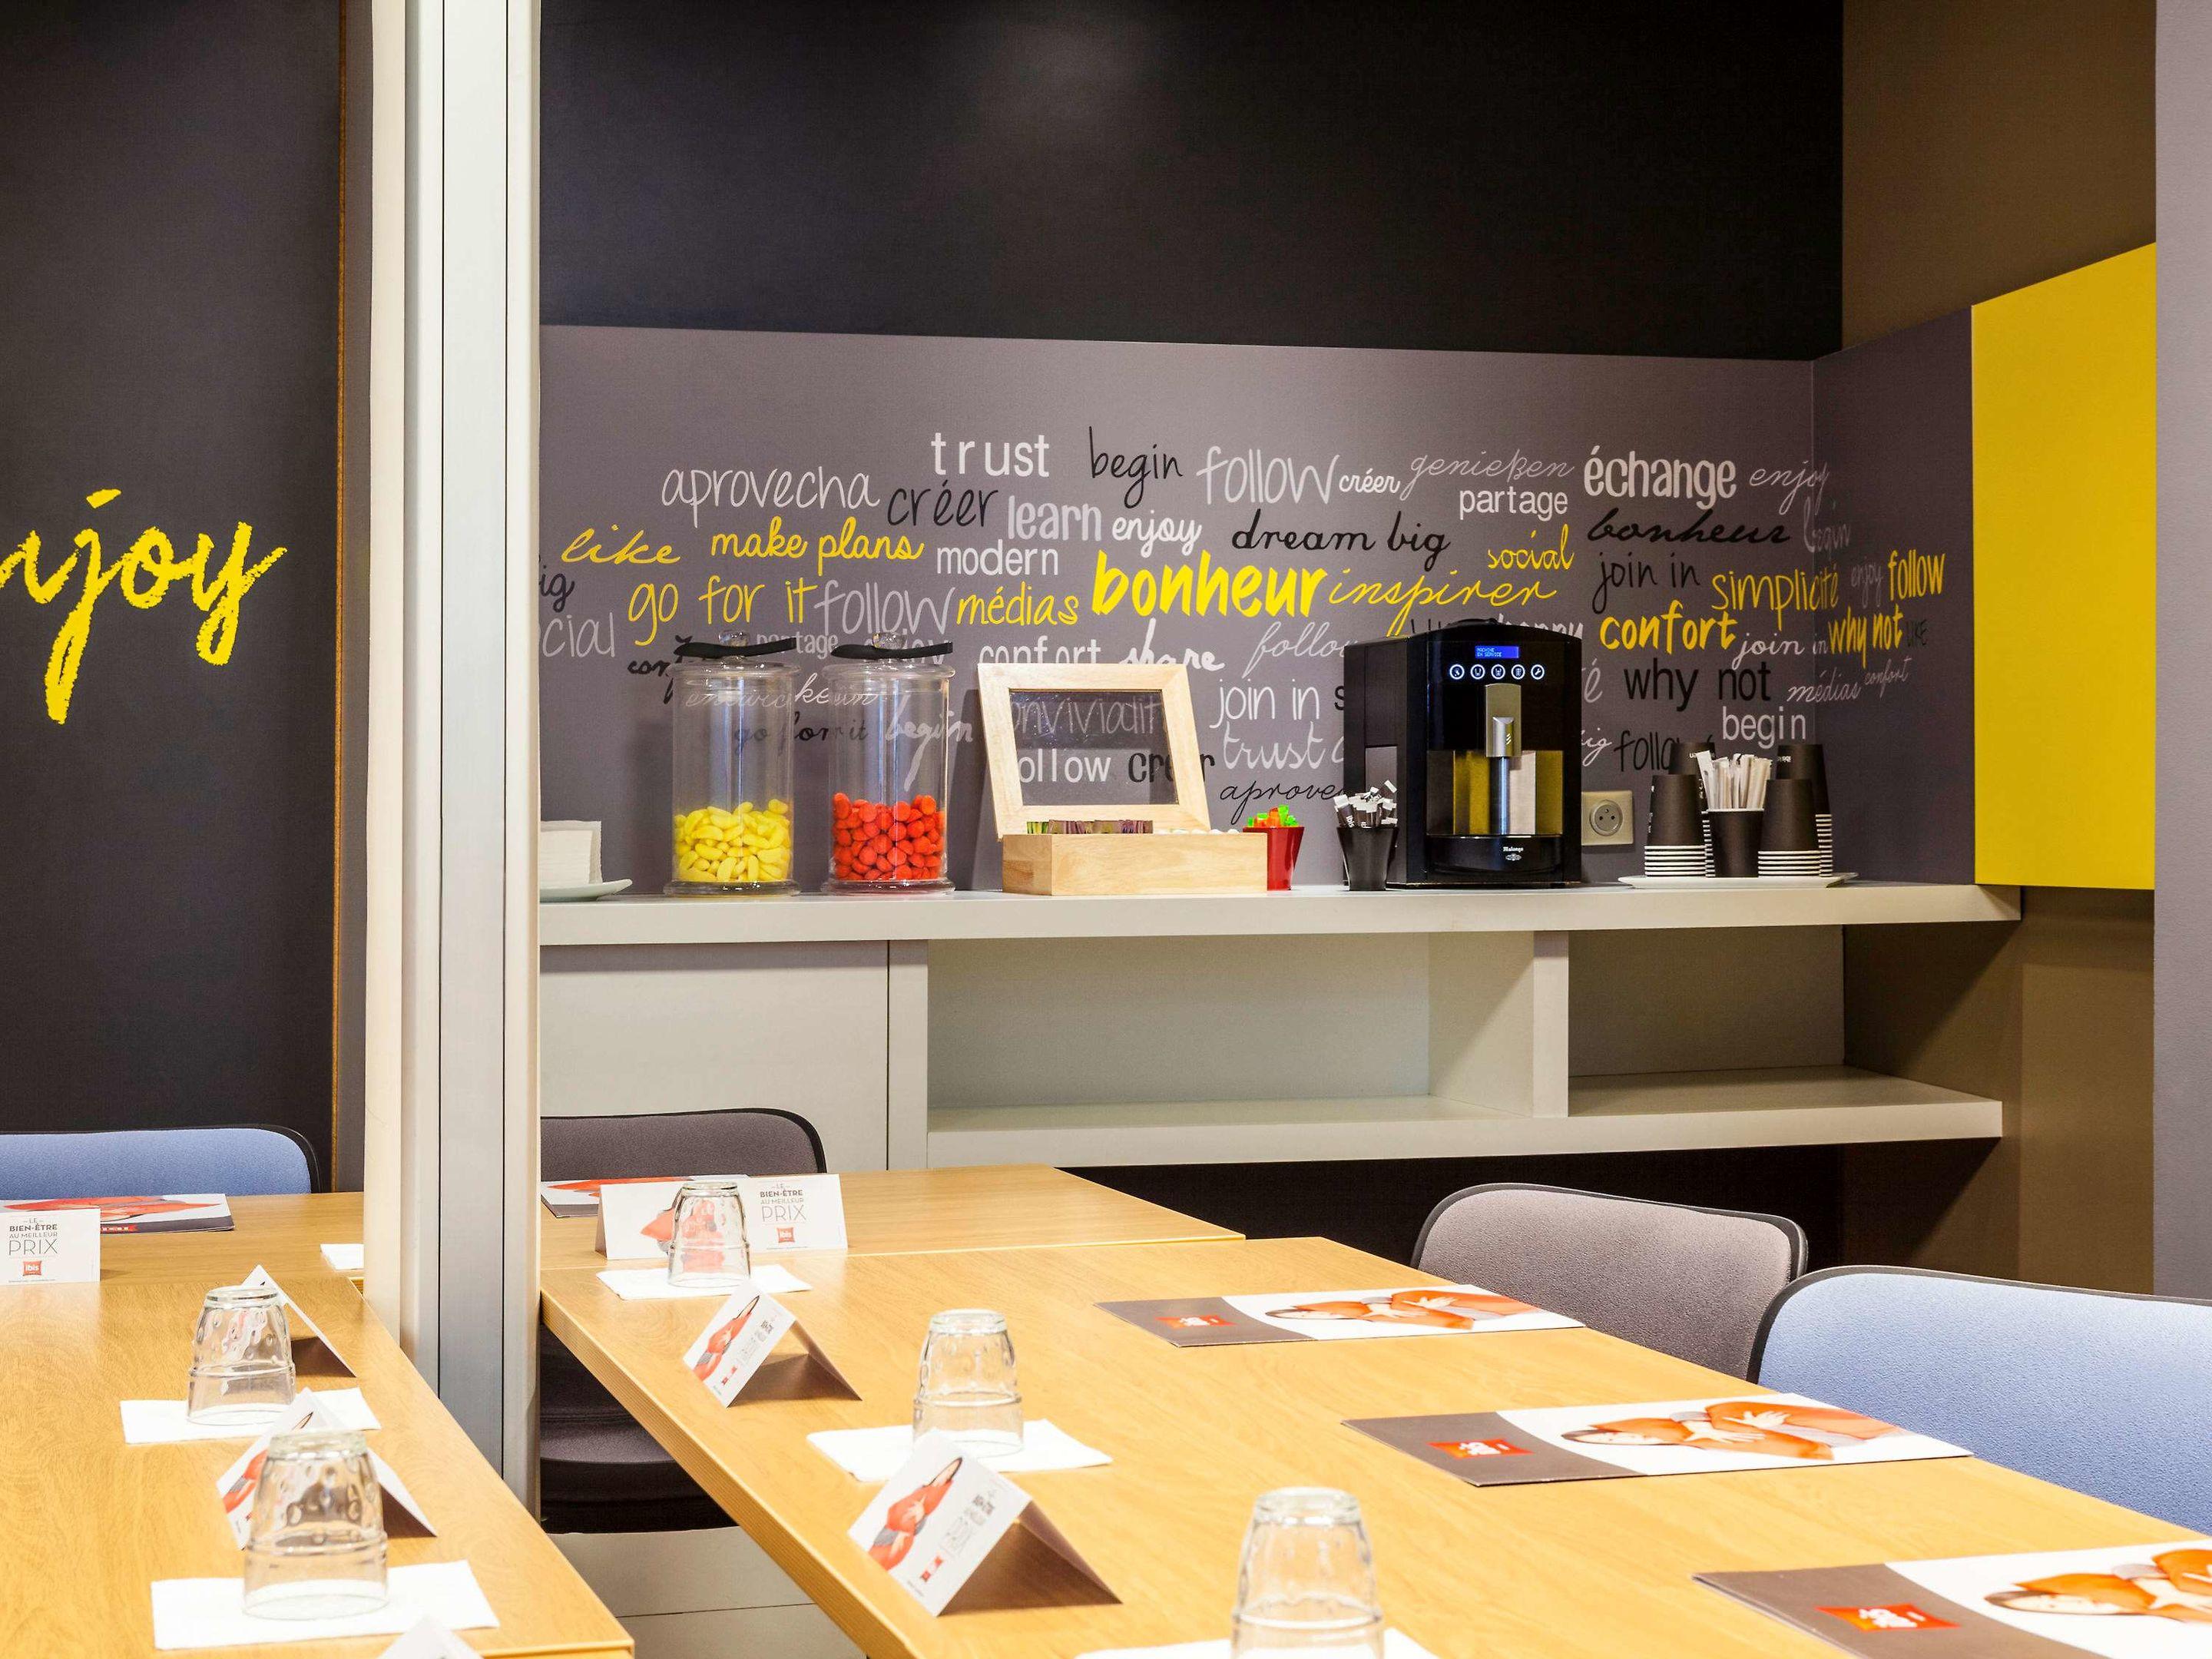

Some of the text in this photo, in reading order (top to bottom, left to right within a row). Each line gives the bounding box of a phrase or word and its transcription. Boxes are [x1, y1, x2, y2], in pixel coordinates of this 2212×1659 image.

[931, 432, 1050, 478] trust
[1088, 426, 1183, 508] begin
[1196, 445, 1340, 505] follow
[1584, 445, 1737, 510] échange
[661, 465, 880, 528] aprovecha
[887, 479, 998, 527] créer
[1339, 468, 1402, 494] créer
[1459, 485, 1568, 522] partage
[1008, 495, 1102, 541] learn
[1111, 510, 1202, 558] enjoy
[1231, 508, 1451, 571] dream big
[1587, 507, 1790, 544] bonheur
[561, 525, 681, 565] like
[711, 515, 925, 576] make plans
[936, 539, 1059, 576] modern
[1488, 523, 1575, 571] social
[538, 565, 575, 613] ig
[1091, 548, 1328, 618] bonheur
[1591, 551, 1700, 614] join in
[1711, 562, 1839, 631] simplicité
[1888, 549, 1945, 601] follow
[628, 575, 818, 647] go for it
[813, 579, 956, 637] follow
[955, 581, 1079, 626] médias
[1328, 568, 1557, 638] inspirer
[1599, 599, 1738, 654] confort
[538, 612, 614, 658] cial
[1732, 632, 1805, 671] join
[1828, 603, 1903, 670] why not
[1209, 678, 1275, 729] join
[1292, 678, 1320, 720] in
[1623, 657, 1698, 711] why
[1718, 661, 1771, 700] not
[1786, 666, 1861, 703] médias
[1223, 720, 1326, 769] trust
[1722, 705, 1806, 749] begin
[1018, 747, 1111, 783] ollow
[1220, 780, 1345, 826] aprove
[9, 1223, 58, 1232] BIEN-ÊTRE
[762, 1204, 806, 1222] PRIX
[9, 1238, 58, 1256] PRIX
